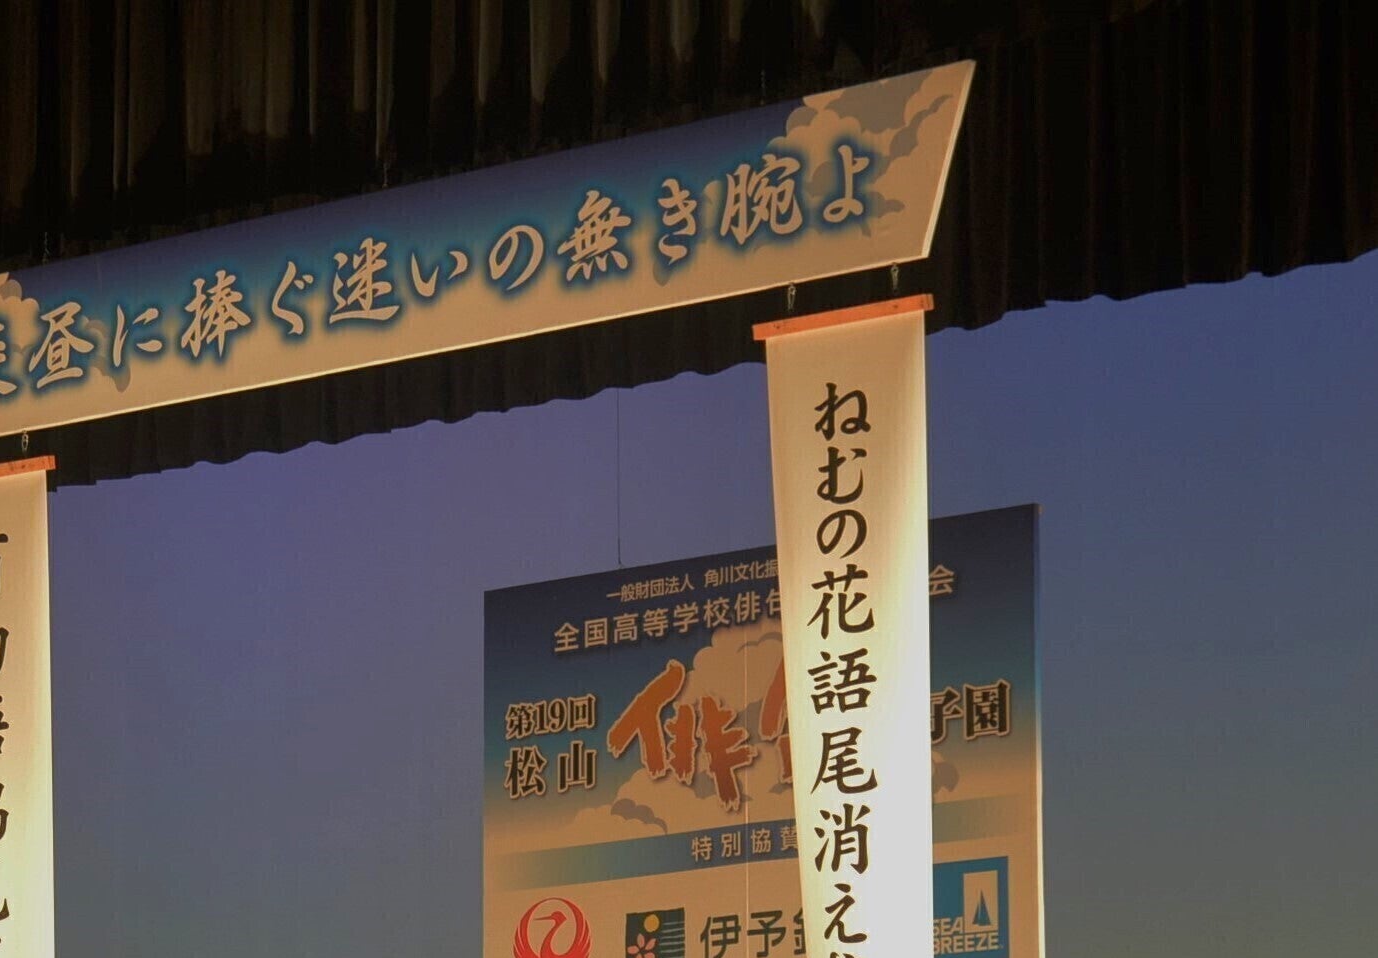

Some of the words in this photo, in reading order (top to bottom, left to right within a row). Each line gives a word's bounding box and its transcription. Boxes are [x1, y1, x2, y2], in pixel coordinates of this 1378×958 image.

[606, 573, 694, 602] 一般財団法人
[505, 693, 596, 740] 第19回
[504, 740, 597, 799] 松山
